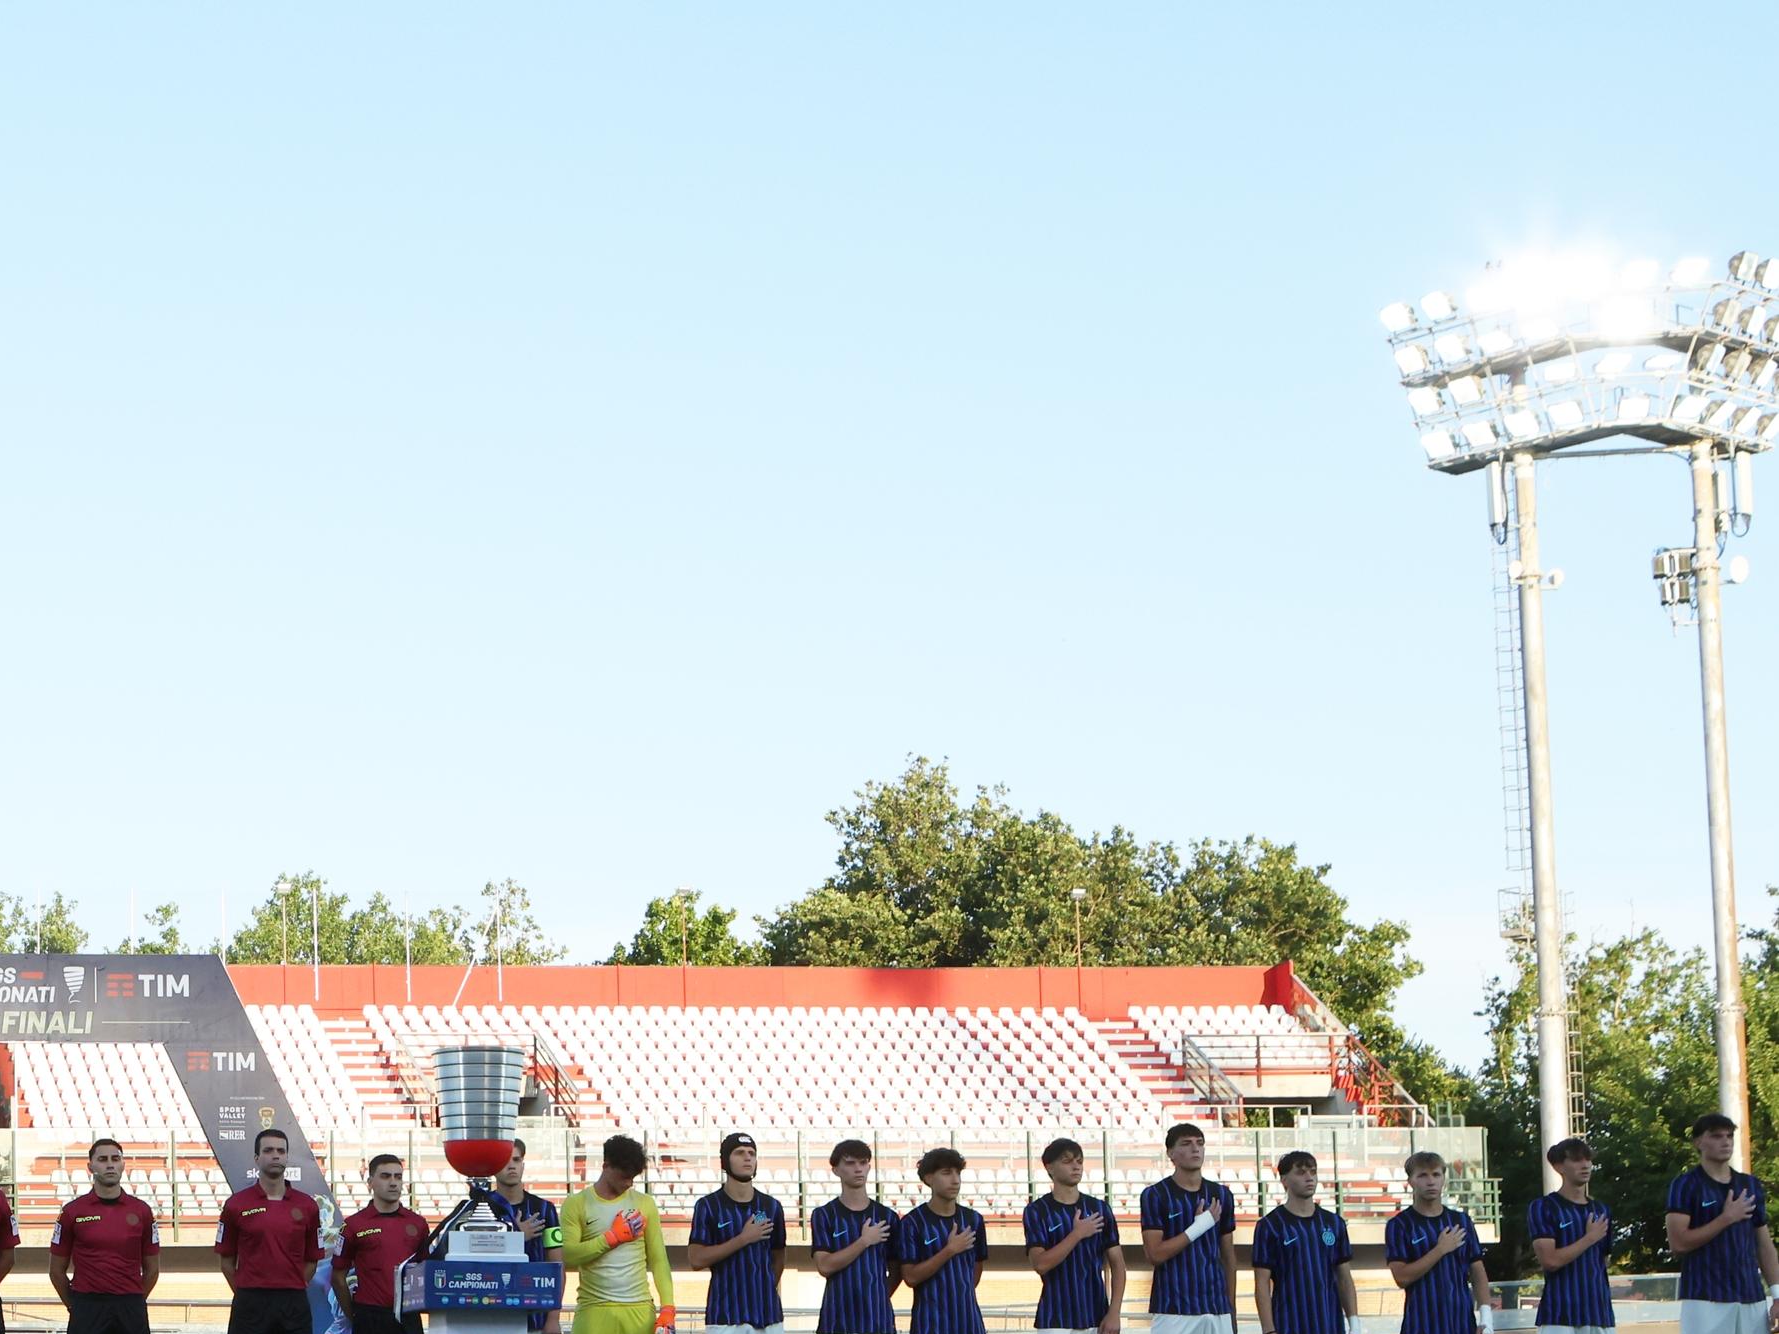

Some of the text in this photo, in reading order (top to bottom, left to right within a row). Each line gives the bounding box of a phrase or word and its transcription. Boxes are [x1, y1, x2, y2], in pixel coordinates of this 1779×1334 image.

[138, 974, 190, 998] TIM
[1, 1010, 94, 1035] FINALI
[213, 1051, 256, 1072] TIM
[246, 1168, 260, 1179] sk
[465, 1273, 482, 1281] SGS
[532, 1277, 555, 1288] TIM
[448, 1280, 499, 1289] CAMPIONATI
